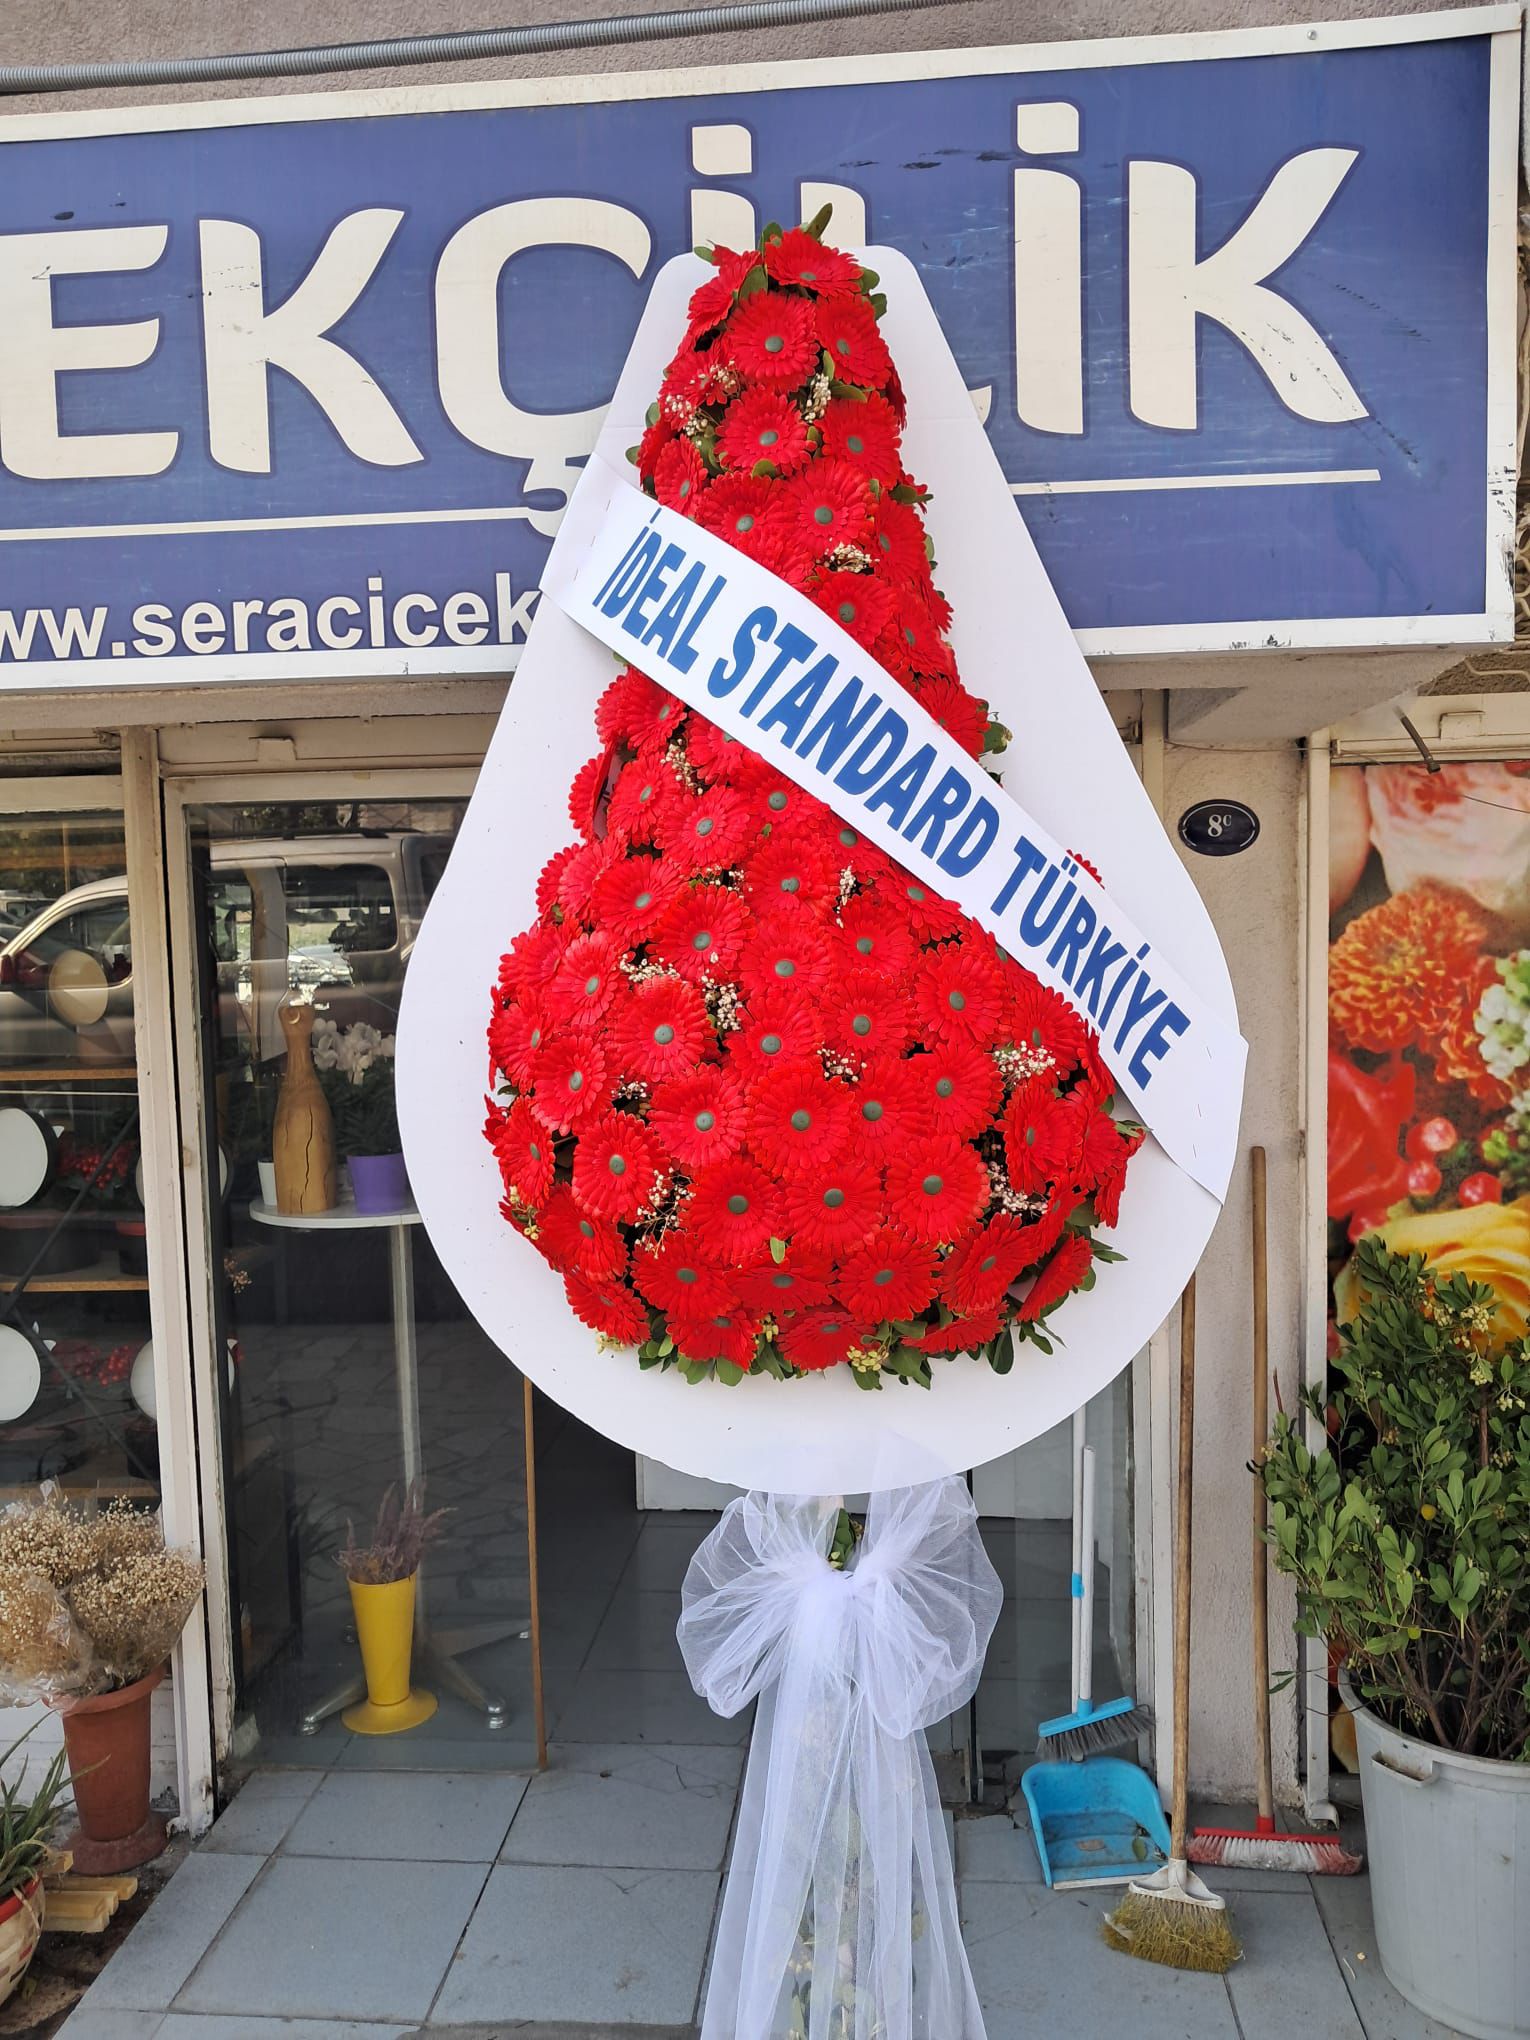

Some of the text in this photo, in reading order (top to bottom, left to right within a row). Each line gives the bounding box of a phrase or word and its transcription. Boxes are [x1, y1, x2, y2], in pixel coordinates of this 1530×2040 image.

[0, 102, 1370, 538] EKÇİK
[592, 507, 1191, 1091] İDEAL STANDARD TÜRKİYE
